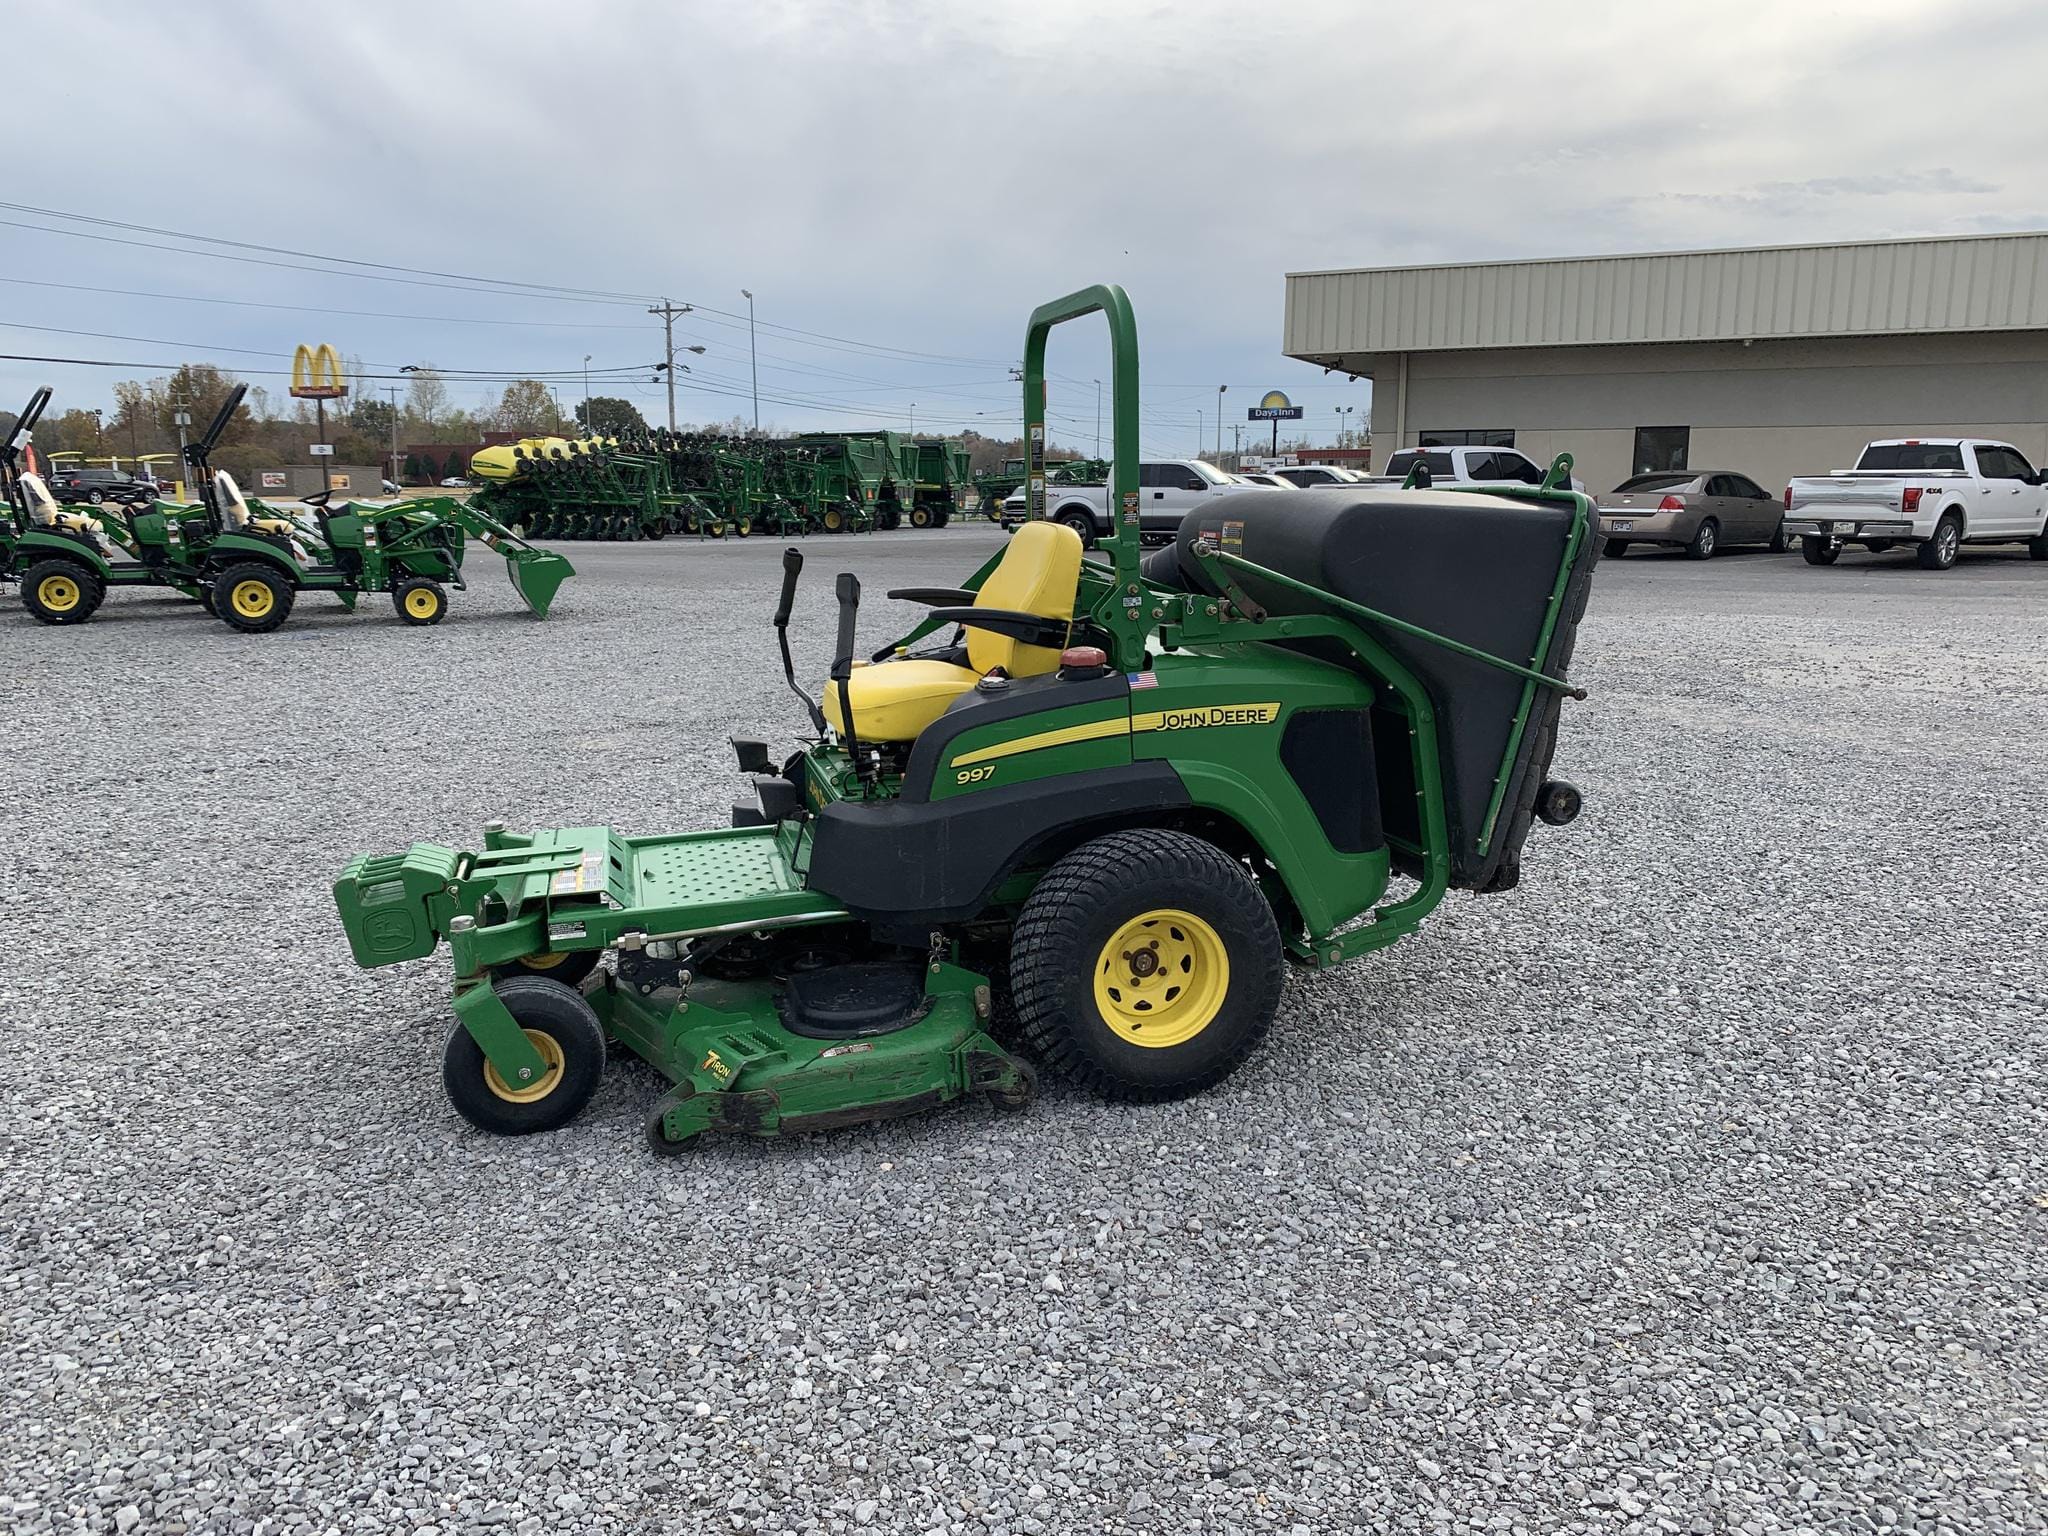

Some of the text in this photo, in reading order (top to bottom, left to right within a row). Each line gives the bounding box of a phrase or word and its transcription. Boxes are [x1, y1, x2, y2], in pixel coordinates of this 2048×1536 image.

[1157, 708, 1268, 730] JOHN DEERE
[957, 765, 996, 785] 997
